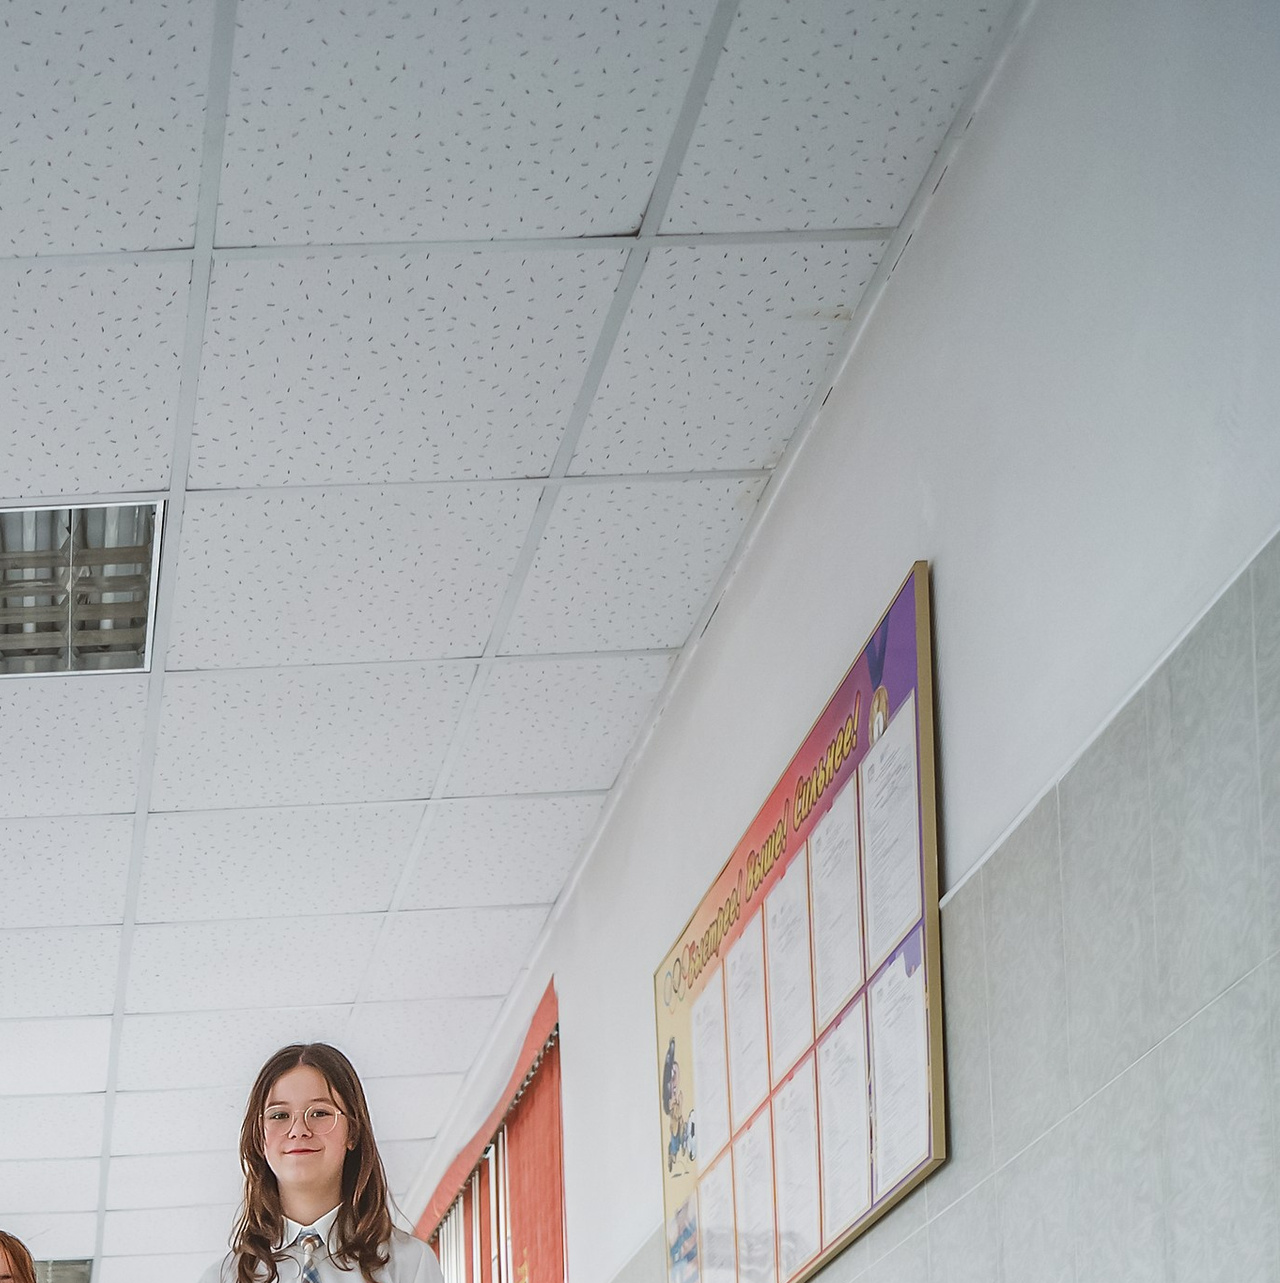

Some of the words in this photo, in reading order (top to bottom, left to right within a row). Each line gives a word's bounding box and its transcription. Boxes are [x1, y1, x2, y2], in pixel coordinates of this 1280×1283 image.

[688, 868, 742, 990] Быстрее!
[745, 797, 790, 903] Выше!
[793, 689, 861, 832] Сильнее!
